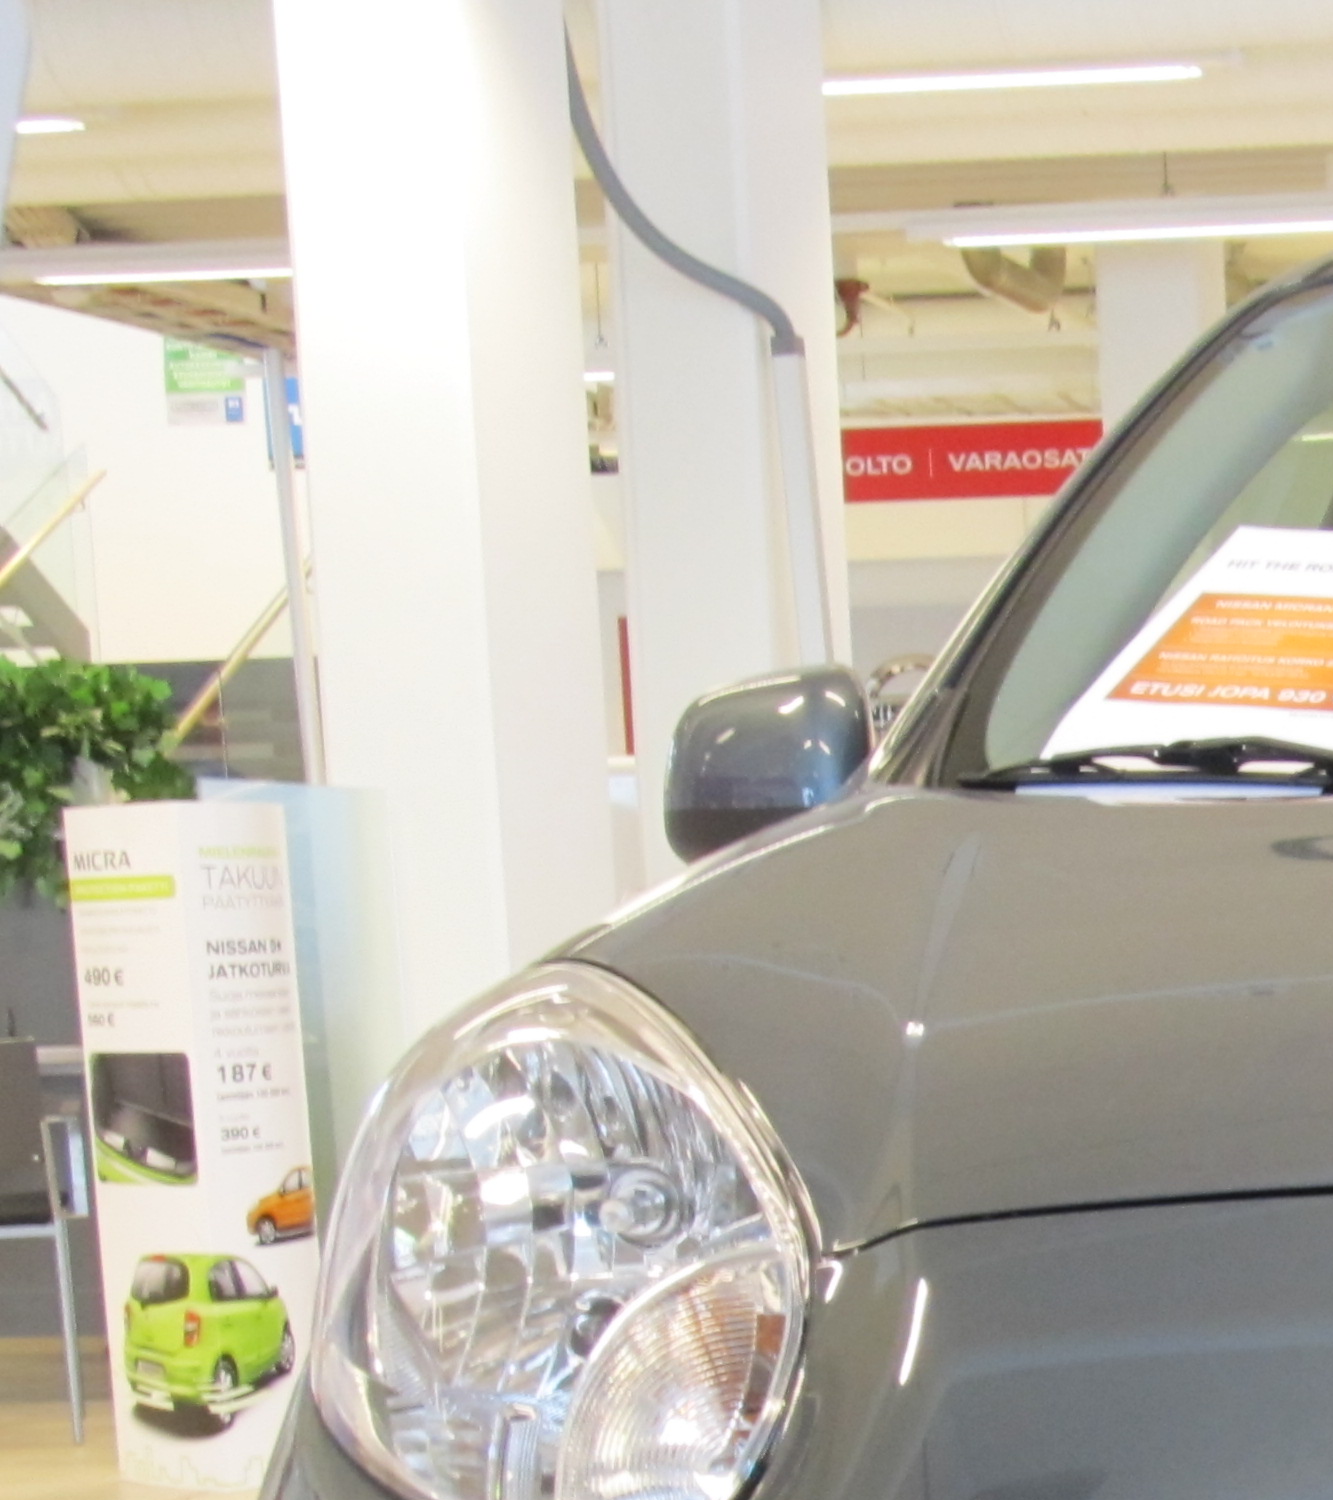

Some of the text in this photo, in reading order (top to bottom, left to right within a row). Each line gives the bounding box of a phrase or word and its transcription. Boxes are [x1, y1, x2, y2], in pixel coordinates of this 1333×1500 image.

[846, 446, 1093, 477] OLTO VARAOSAT
[1226, 558, 1259, 569] HIT
[1265, 560, 1301, 571] THE
[1129, 681, 1208, 697] ETUSI
[1208, 683, 1272, 700] JOPA
[1277, 688, 1326, 704] 930
[73, 849, 132, 873] MICRA
[206, 938, 268, 956] NISSAN
[85, 967, 112, 987] 490
[217, 1061, 273, 1084] 187 €
